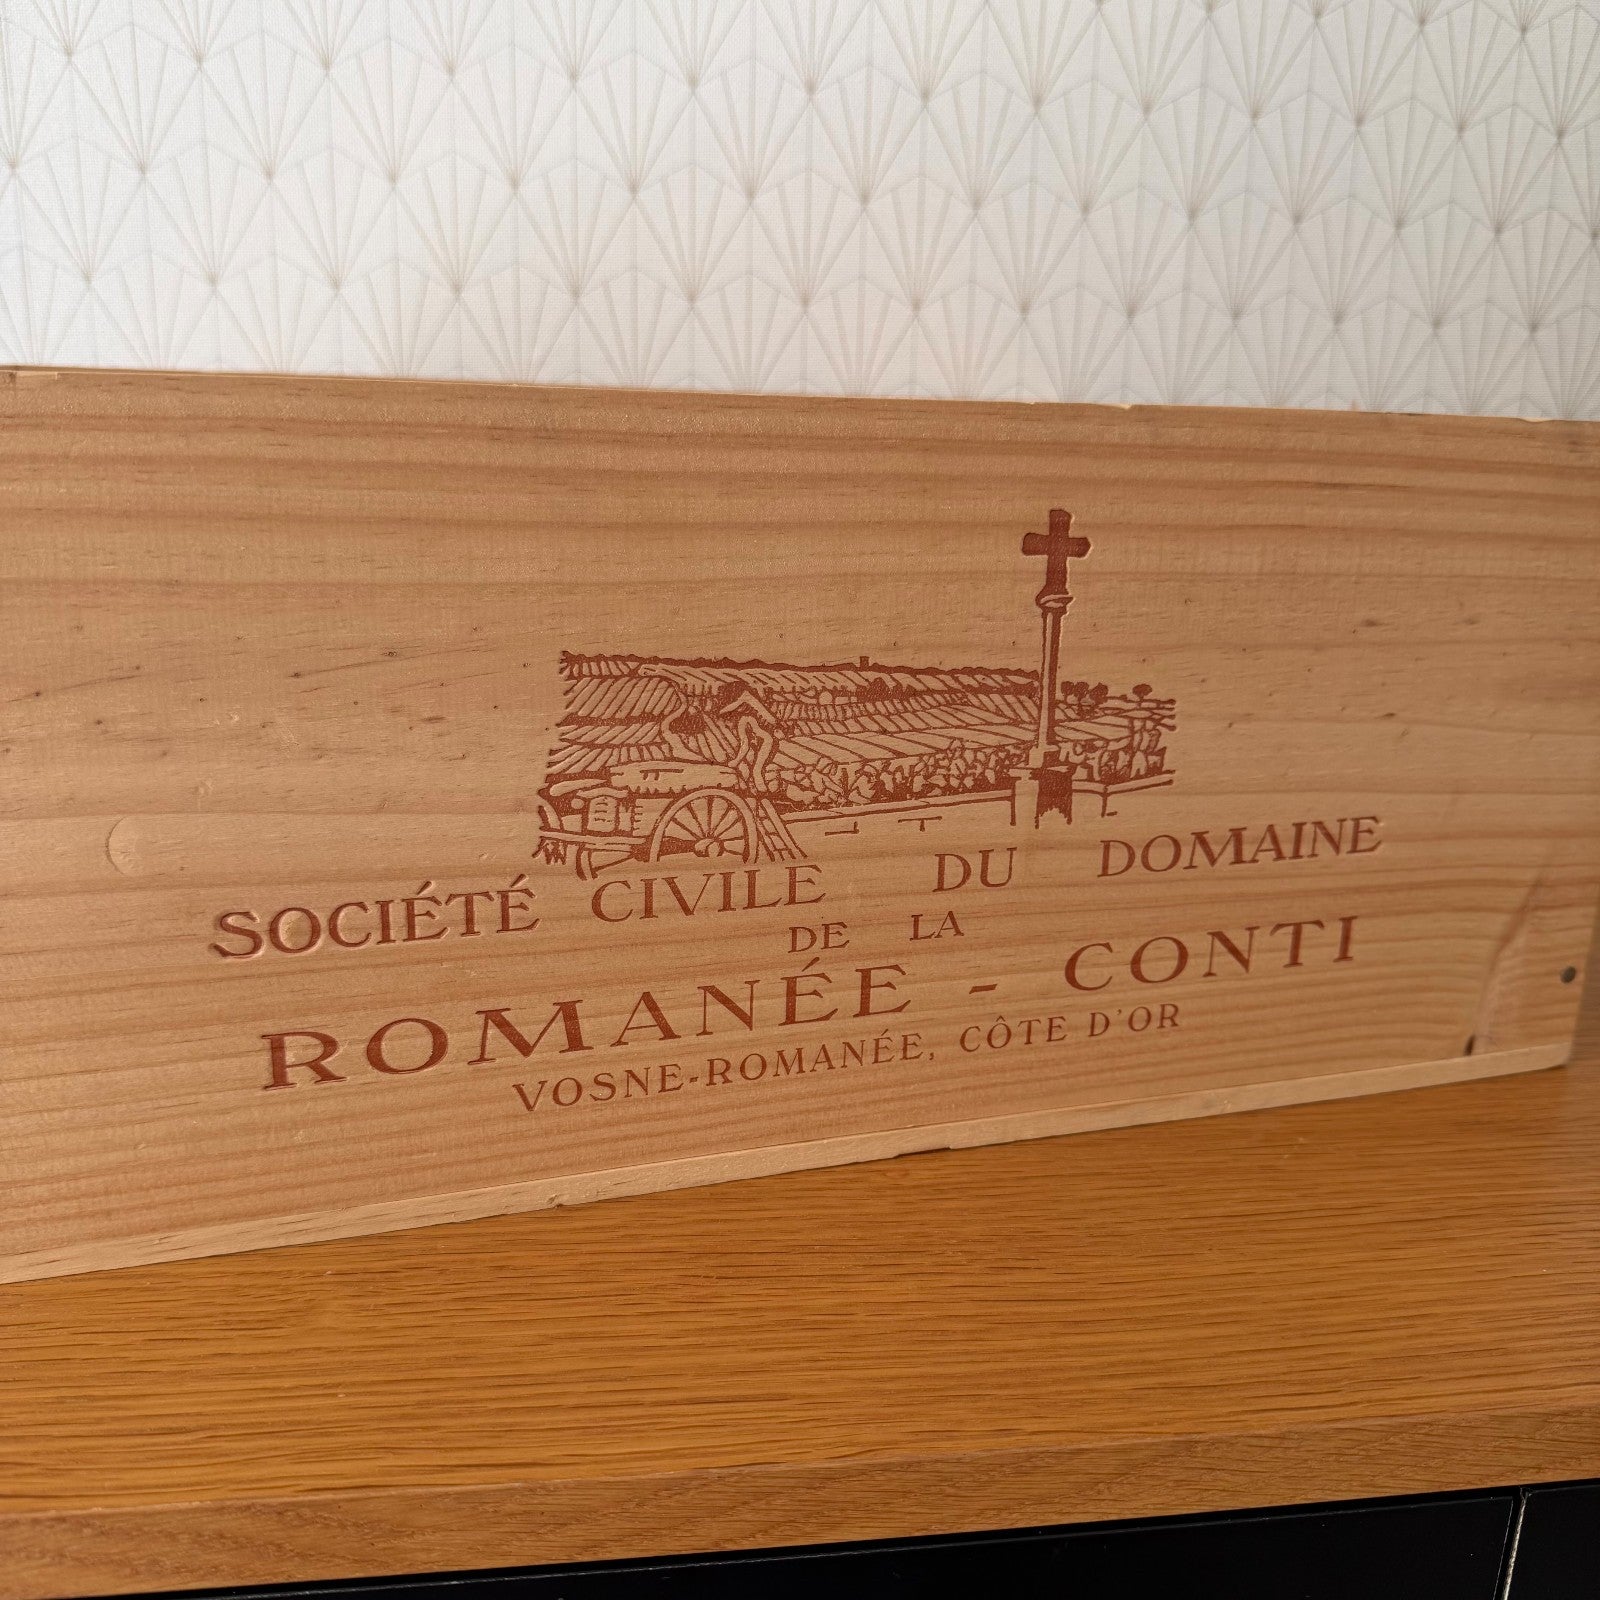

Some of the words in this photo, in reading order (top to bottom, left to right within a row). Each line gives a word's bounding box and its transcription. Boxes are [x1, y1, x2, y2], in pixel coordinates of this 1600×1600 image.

[210, 873, 540, 960] SOCIÉTÉ
[591, 864, 827, 923] CIVILE
[932, 847, 1018, 893] DU
[1097, 815, 1383, 879] DOMAINE
[788, 921, 852, 953] DE
[909, 910, 964, 941] LA
[261, 957, 912, 1092] ROMANÉE
[1064, 915, 1359, 992] CONTI
[512, 1029, 937, 1112] VOSNE-ROMANÉE,
[959, 1015, 1068, 1054] CÔTE
[1088, 1002, 1181, 1038] D'OR
